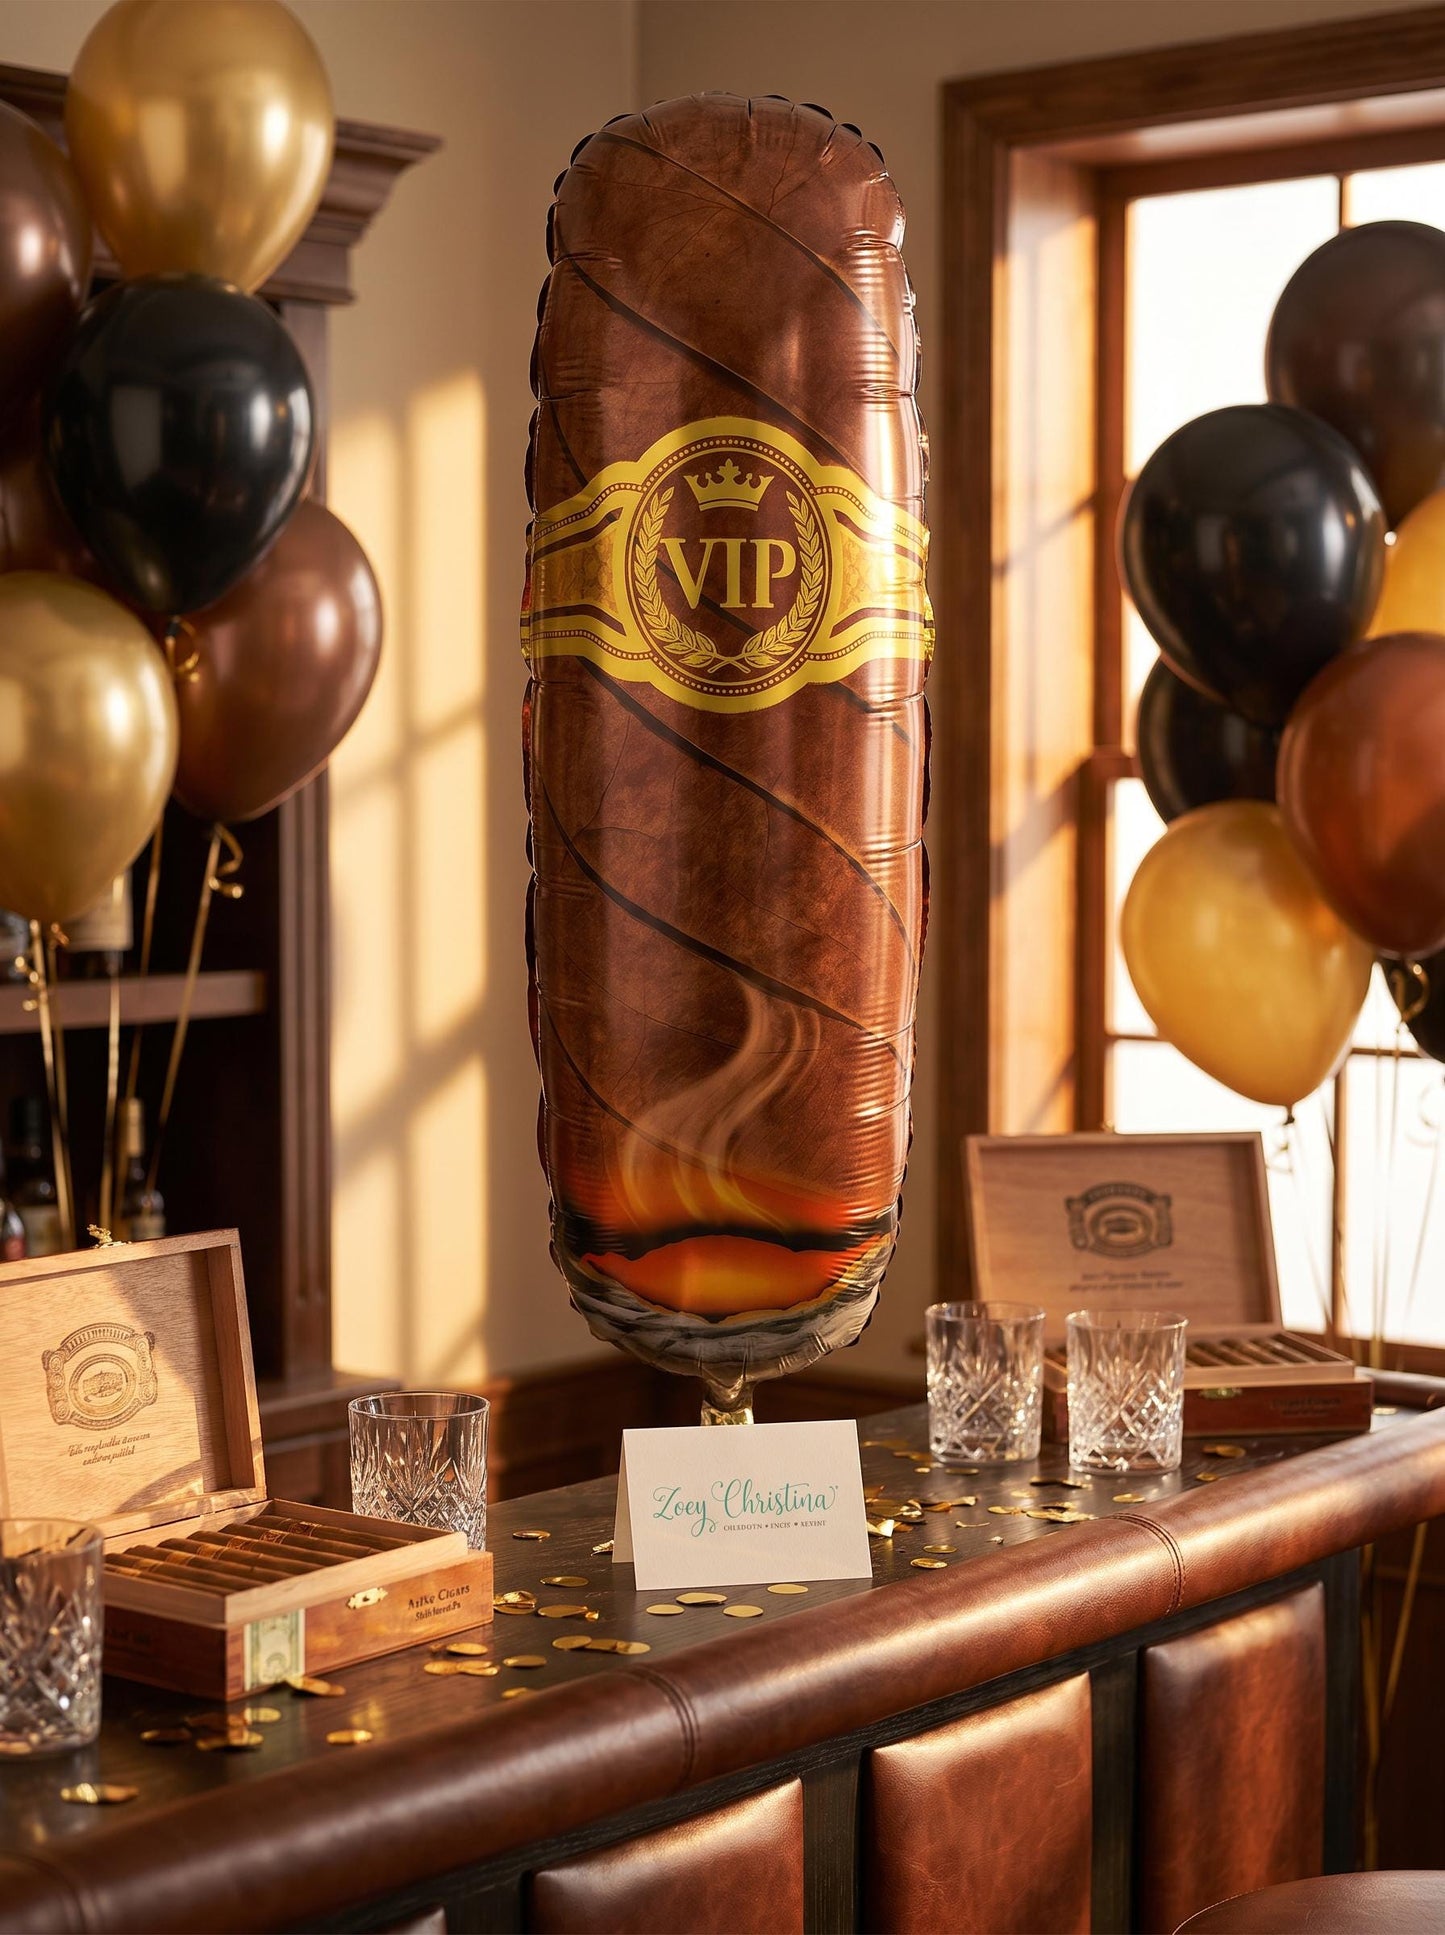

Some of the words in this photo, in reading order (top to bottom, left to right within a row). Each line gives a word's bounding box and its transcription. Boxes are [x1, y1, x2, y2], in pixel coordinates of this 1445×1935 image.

[659, 537, 797, 610] VIP
[652, 1486, 718, 1538] Zoey
[711, 1478, 839, 1519] Christina
